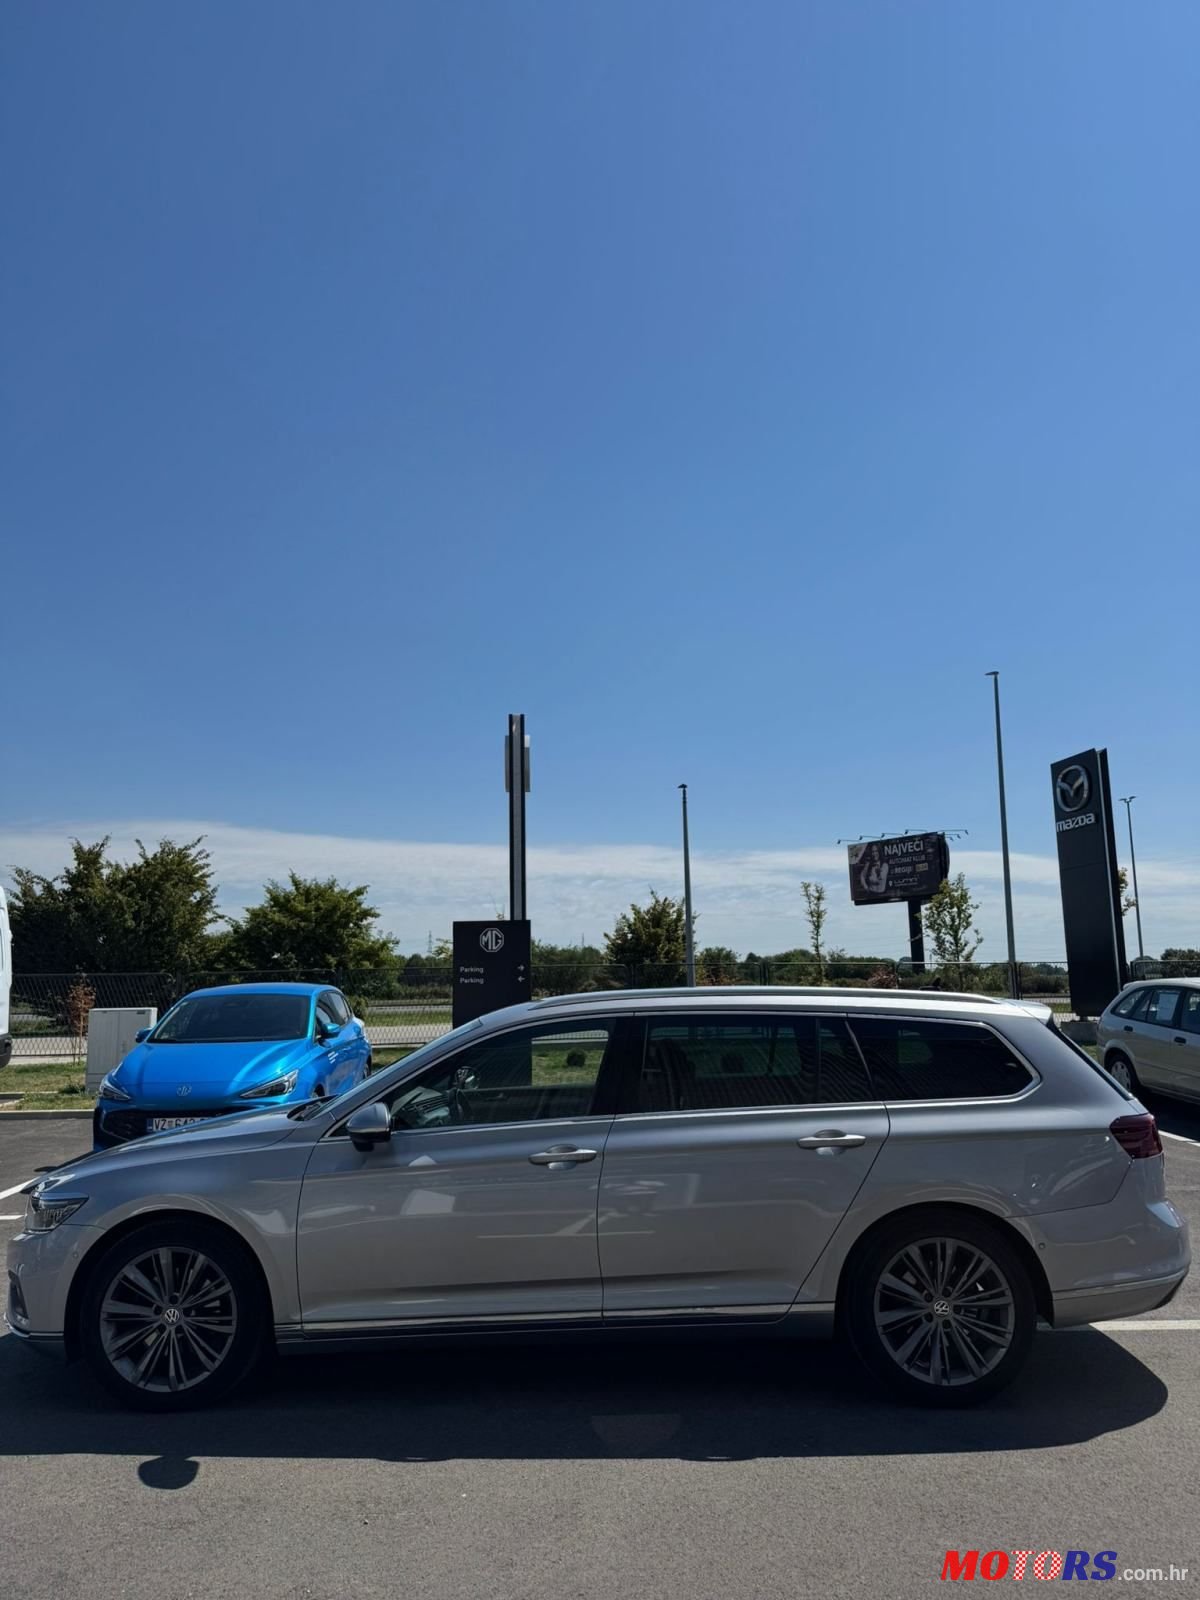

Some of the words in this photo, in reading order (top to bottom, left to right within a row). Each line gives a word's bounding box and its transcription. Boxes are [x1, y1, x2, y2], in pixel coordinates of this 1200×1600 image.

[482, 930, 502, 950] MG
[460, 966, 484, 974] Parking
[460, 977, 484, 985] Parking
[154, 1119, 167, 1131] VZ
